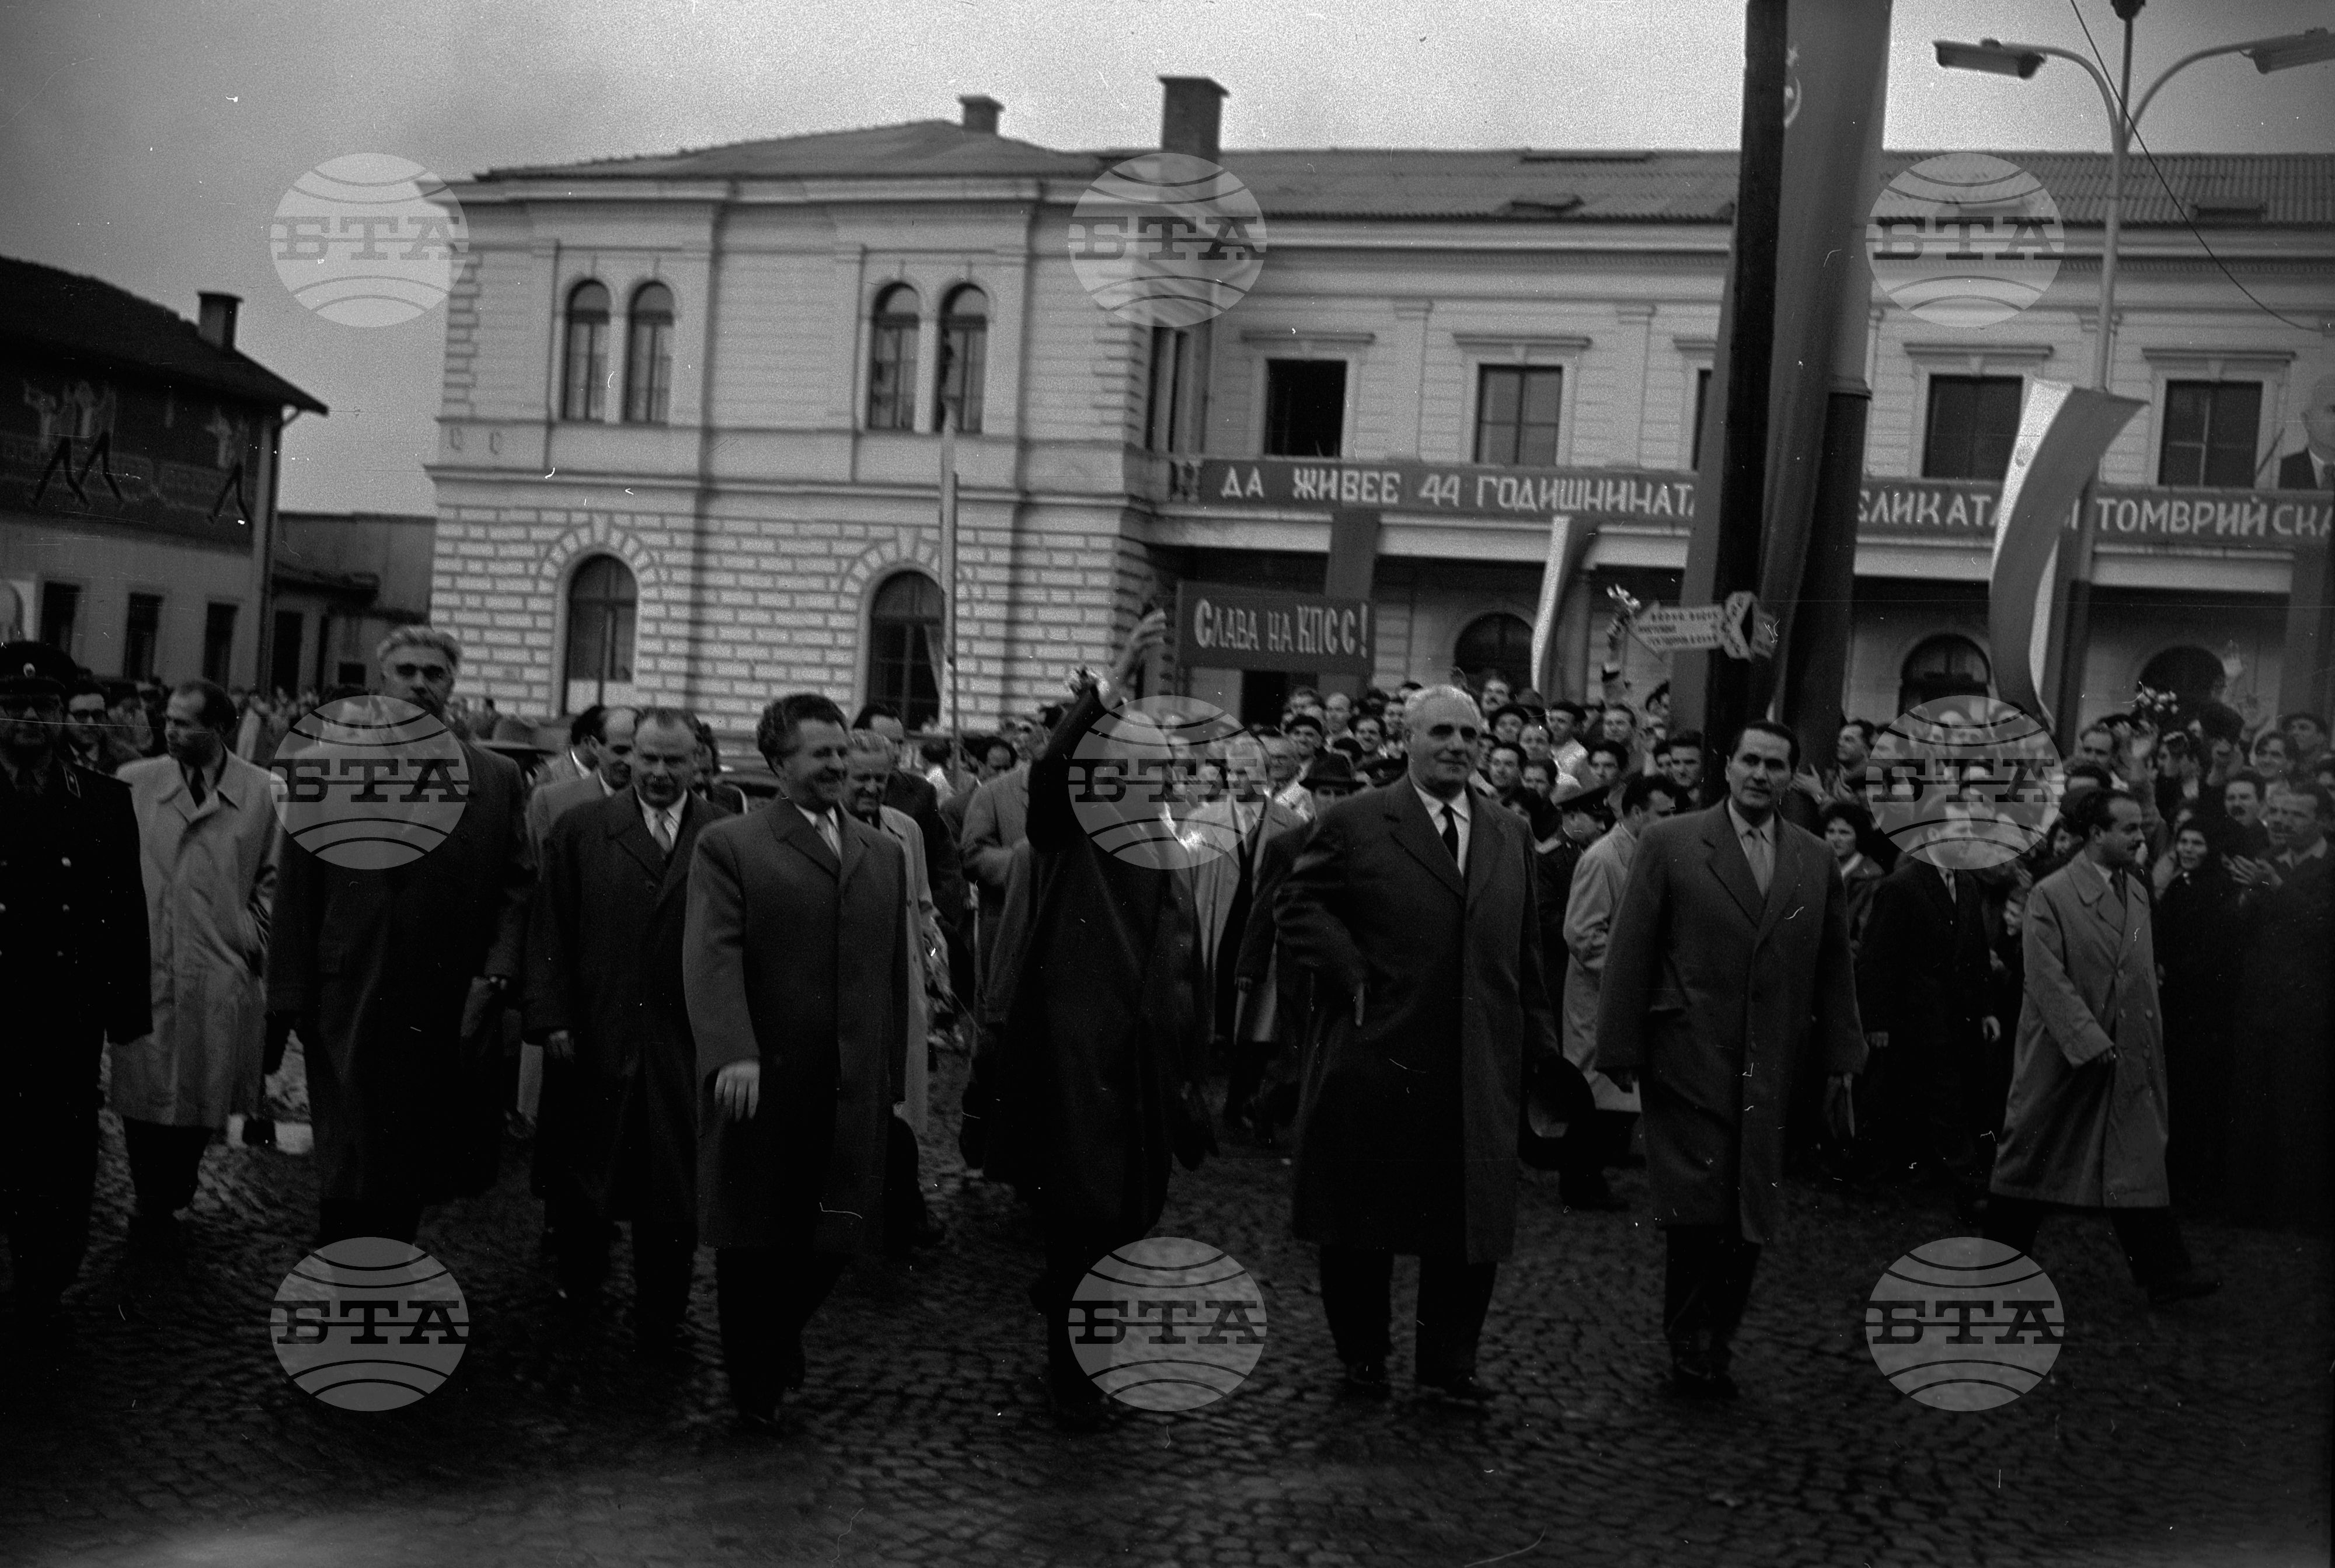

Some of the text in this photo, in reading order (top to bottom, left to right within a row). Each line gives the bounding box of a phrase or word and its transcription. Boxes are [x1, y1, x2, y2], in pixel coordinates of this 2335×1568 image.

[1221, 466, 1695, 518] ДА ЖИВЕЕ 44 ГОДИШНИНАТ
[1858, 490, 2002, 527] ЕЛИКАТ
[1297, 602, 1368, 658] КПСС!
